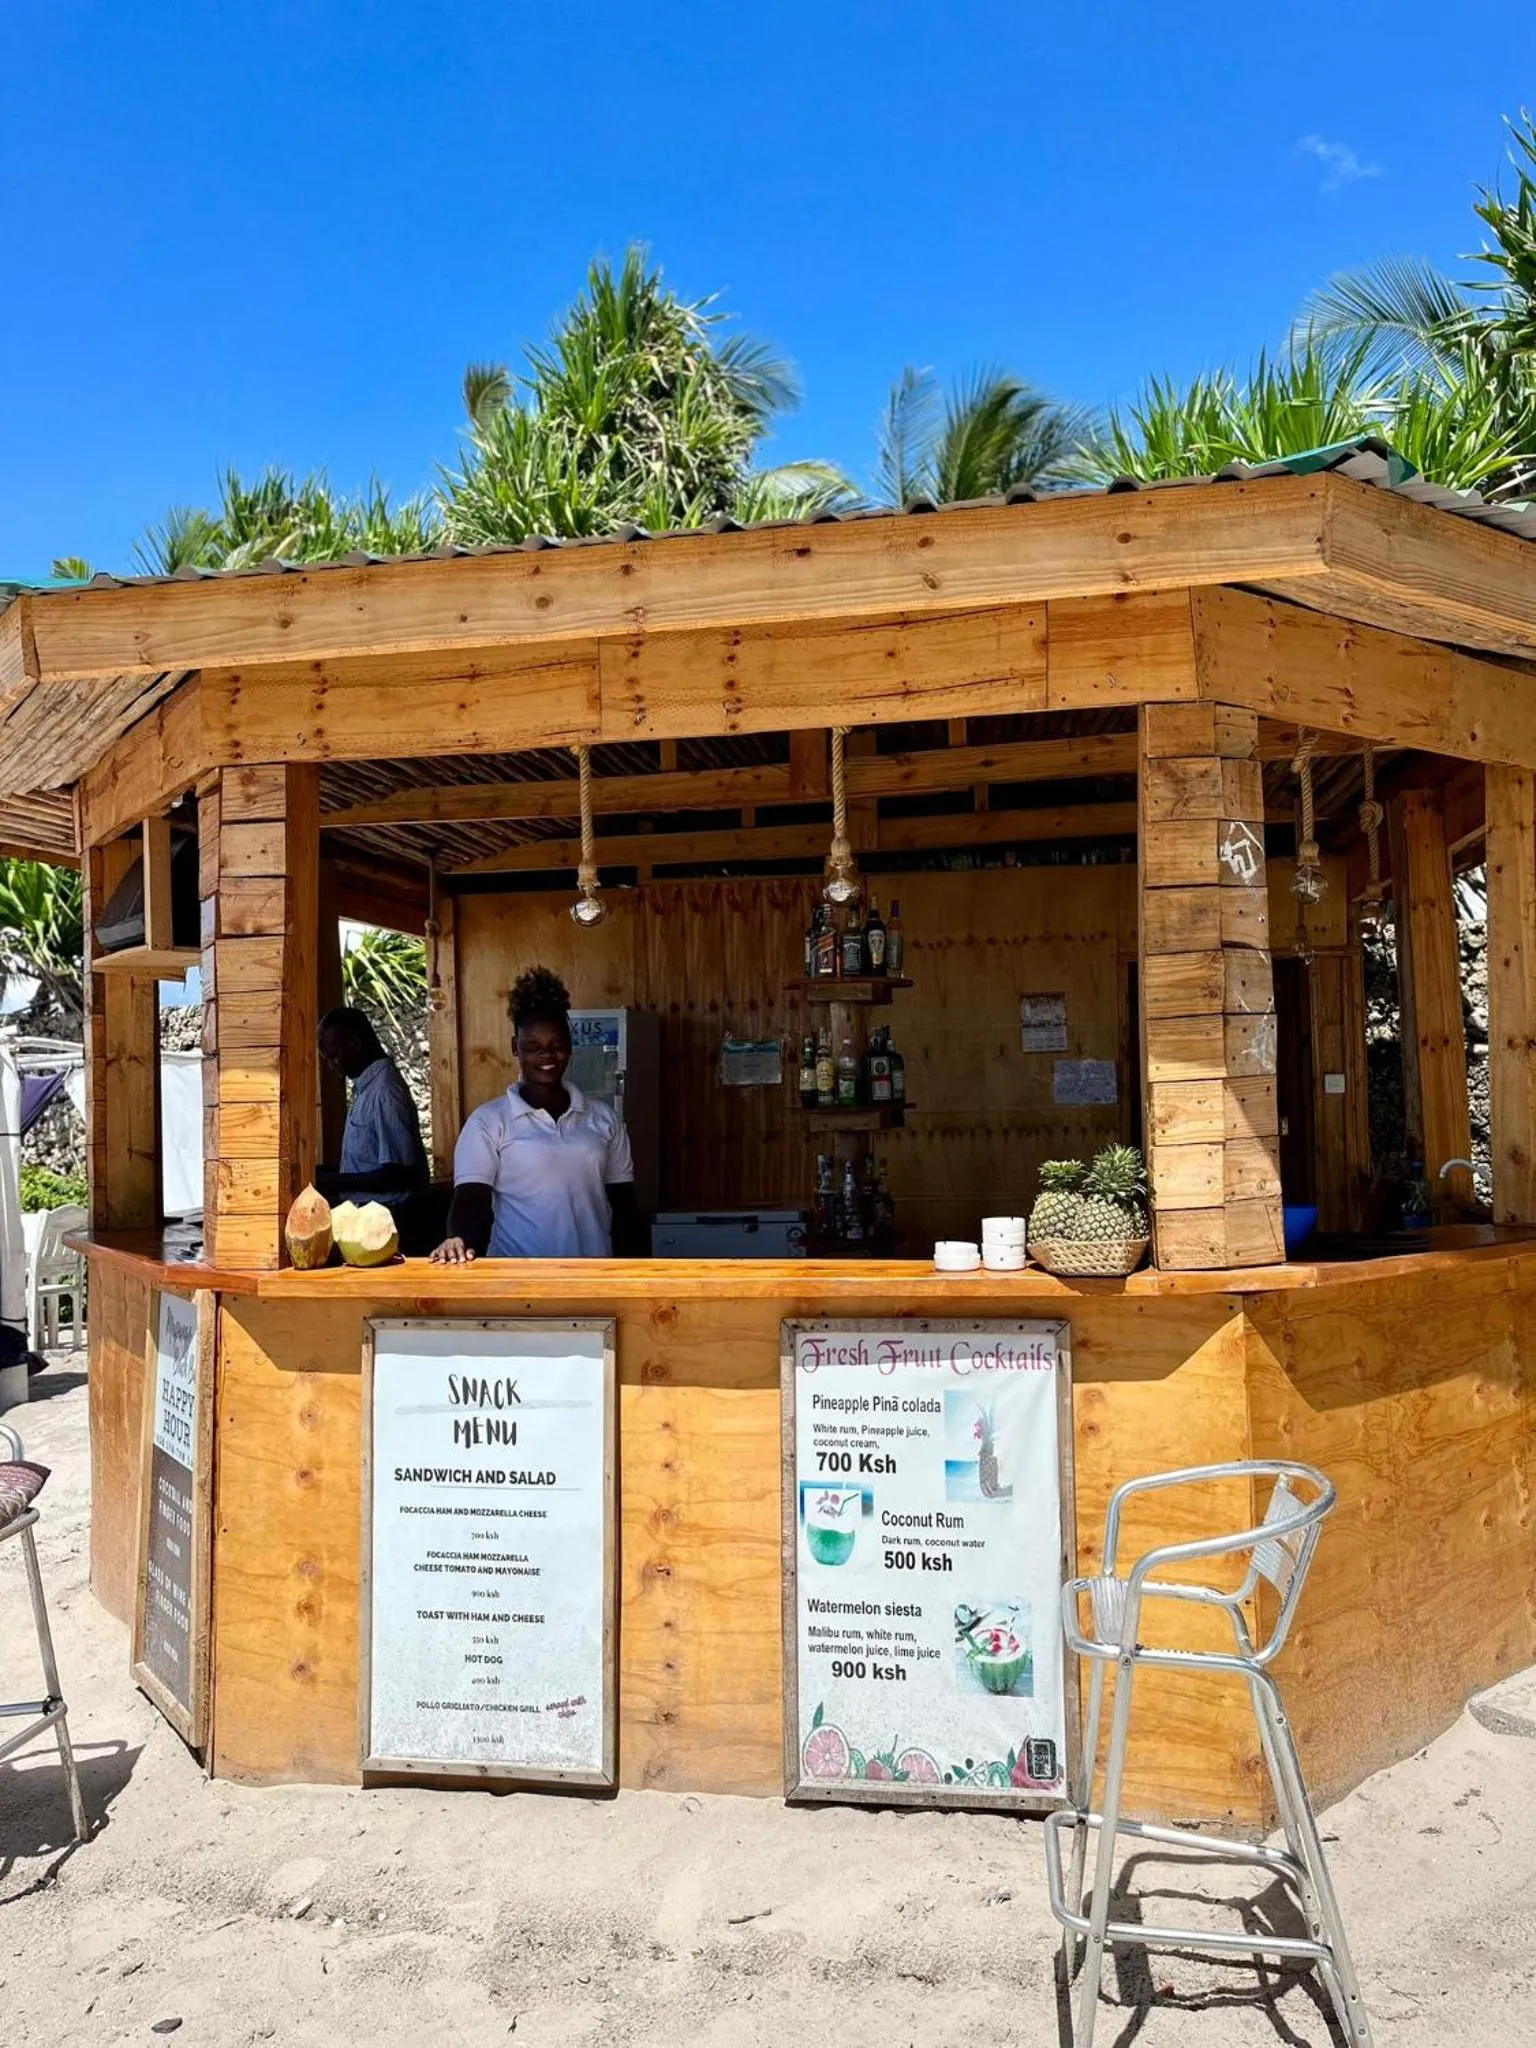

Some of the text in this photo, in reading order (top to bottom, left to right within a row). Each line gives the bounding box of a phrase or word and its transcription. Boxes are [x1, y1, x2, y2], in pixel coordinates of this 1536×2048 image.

[570, 1022, 602, 1034] XUS
[800, 1338, 1054, 1376] Fresh Fruit Cocktails
[162, 1377, 195, 1418] HAPPY
[447, 1373, 523, 1410] SNACK
[812, 1394, 870, 1414] Pineapple
[902, 1397, 941, 1413] colada
[163, 1408, 190, 1449] HOUR
[453, 1417, 517, 1449] MENU
[813, 1424, 838, 1434] White
[861, 1425, 904, 1437] Pineapple
[813, 1438, 849, 1448] coconut
[816, 1452, 897, 1474] 700 Ksh
[394, 1468, 556, 1485] SANDWICH AND SALAD
[400, 1506, 548, 1518] FOCACCIA HAM AND MOZZARELLA CHEESE
[881, 1511, 964, 1528] Coconut Rum
[881, 1536, 902, 1545] Dark
[925, 1538, 960, 1547] coconut
[962, 1540, 985, 1548] water
[427, 1551, 529, 1562] FOCACCIA HAM MOZZARELLA
[884, 1551, 953, 1571] 500 ksh
[413, 1564, 443, 1573] CHEESE
[445, 1565, 476, 1574] TOMATO
[477, 1566, 494, 1575] AND
[807, 1599, 922, 1617] Watermelon siesta
[416, 1610, 545, 1624] TOAST WITH HAM AND CHEESE
[808, 1626, 840, 1638] Malibu
[866, 1629, 892, 1641] white
[465, 1654, 503, 1664] HOT DOG
[808, 1643, 863, 1655] watermelon
[894, 1647, 915, 1658] lime
[917, 1647, 941, 1659] juice
[832, 1660, 907, 1681] 900 ksh
[416, 1701, 440, 1709] POLLO
